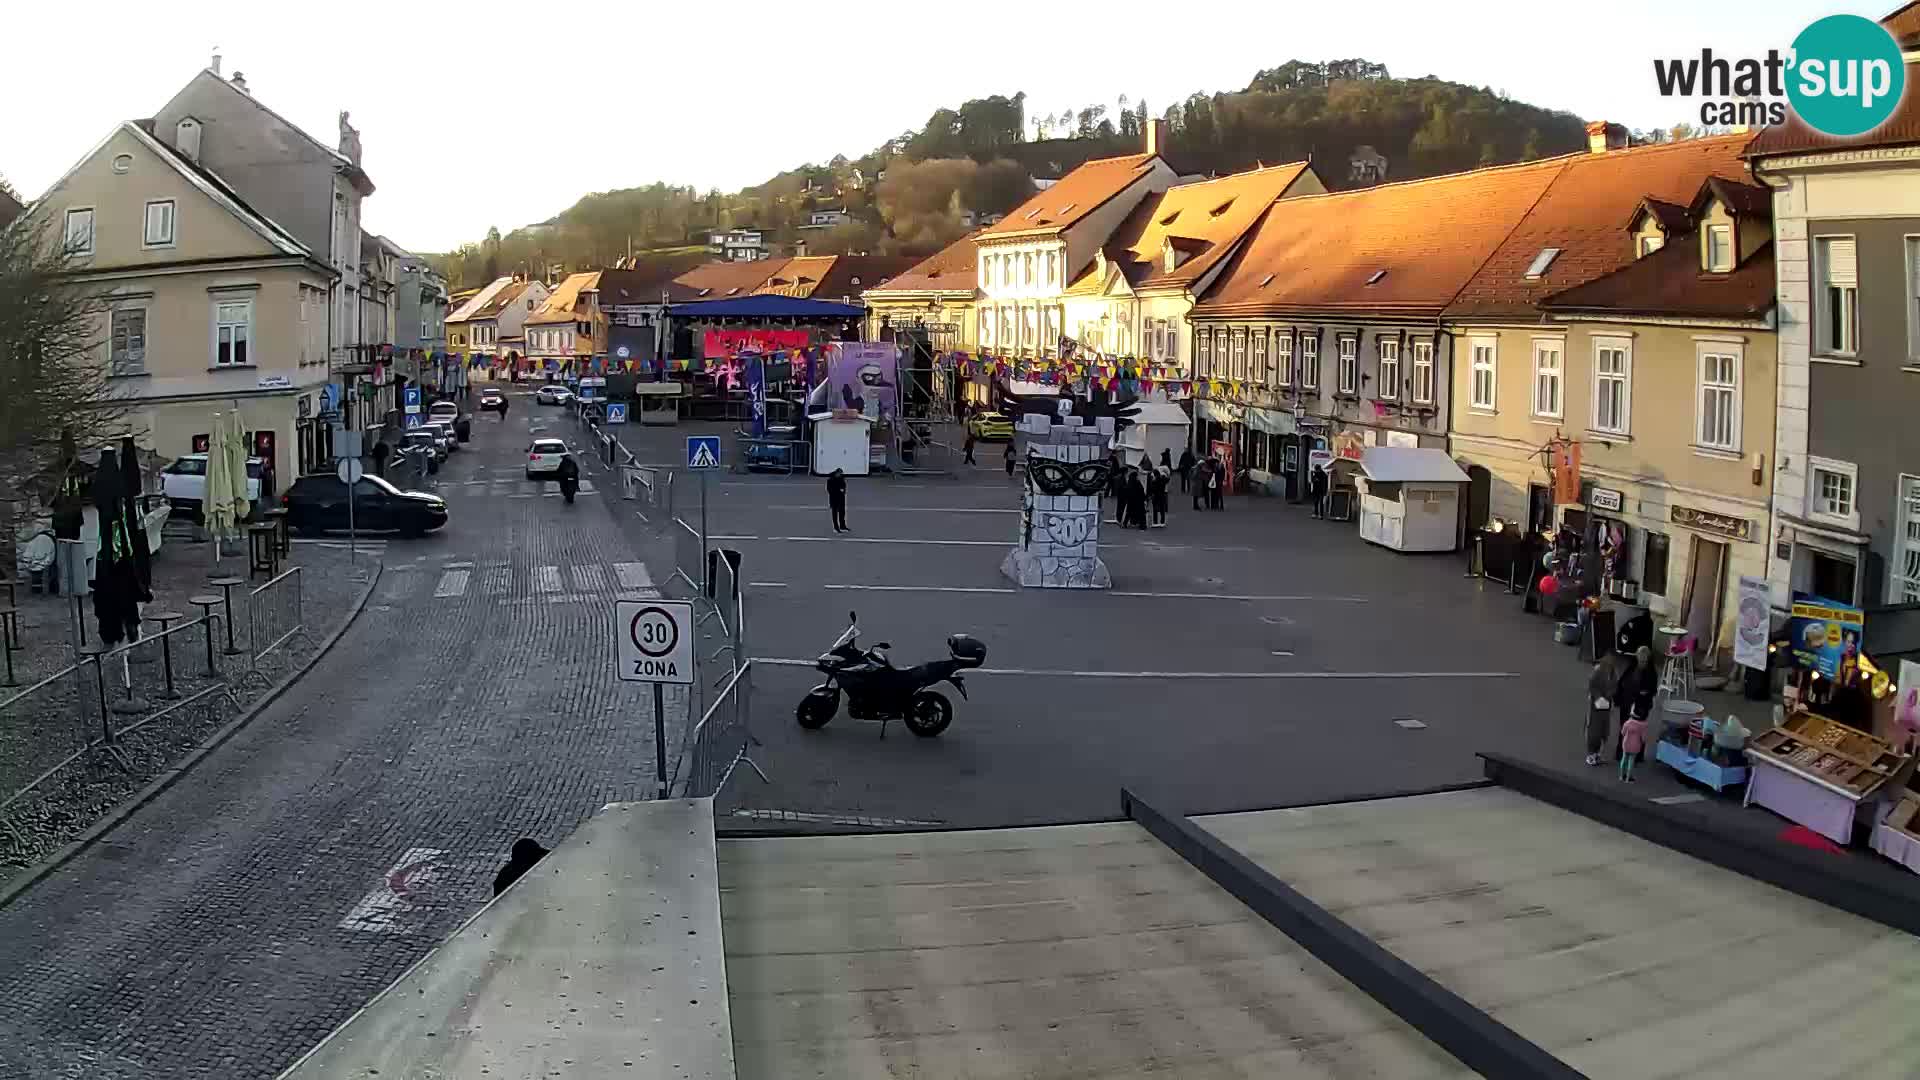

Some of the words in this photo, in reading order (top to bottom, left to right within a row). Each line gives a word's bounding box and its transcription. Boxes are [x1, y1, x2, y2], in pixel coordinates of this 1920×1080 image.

[408, 391, 417, 402] P
[1048, 516, 1087, 545] 200
[643, 622, 667, 643] 30
[633, 660, 678, 676] ZONA
